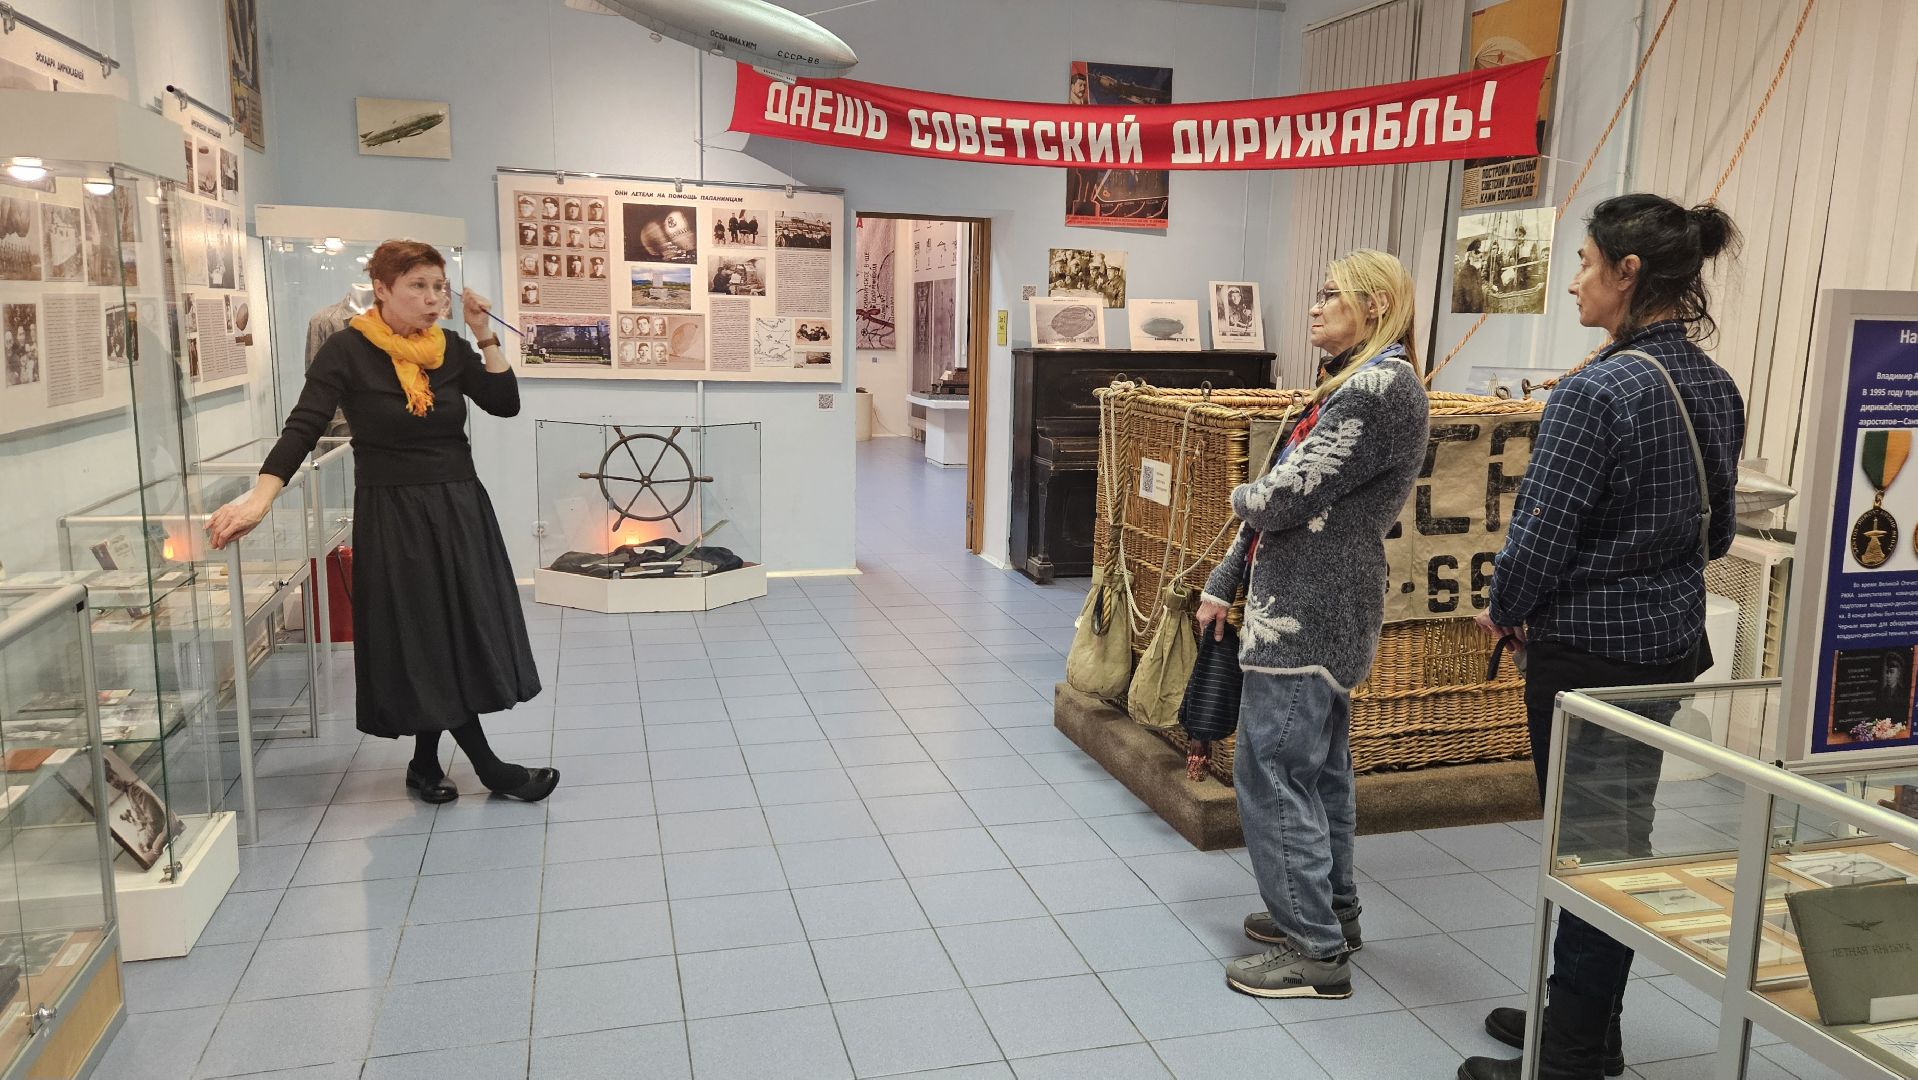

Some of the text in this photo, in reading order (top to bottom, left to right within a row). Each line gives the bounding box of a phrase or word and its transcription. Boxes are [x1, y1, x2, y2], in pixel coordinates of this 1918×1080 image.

[710, 30, 757, 51] ОСОАВИАХИМ
[765, 80, 1498, 164] ДАЕШЬ СОВЕТСКИЙ ДИРИЖАБЛЬ!
[1877, 371, 1912, 381] Владимир
[1862, 388, 1868, 396] В
[1870, 388, 1886, 396] 1995
[1888, 390, 1903, 398] году
[1283, 977, 1302, 985] PUMA
